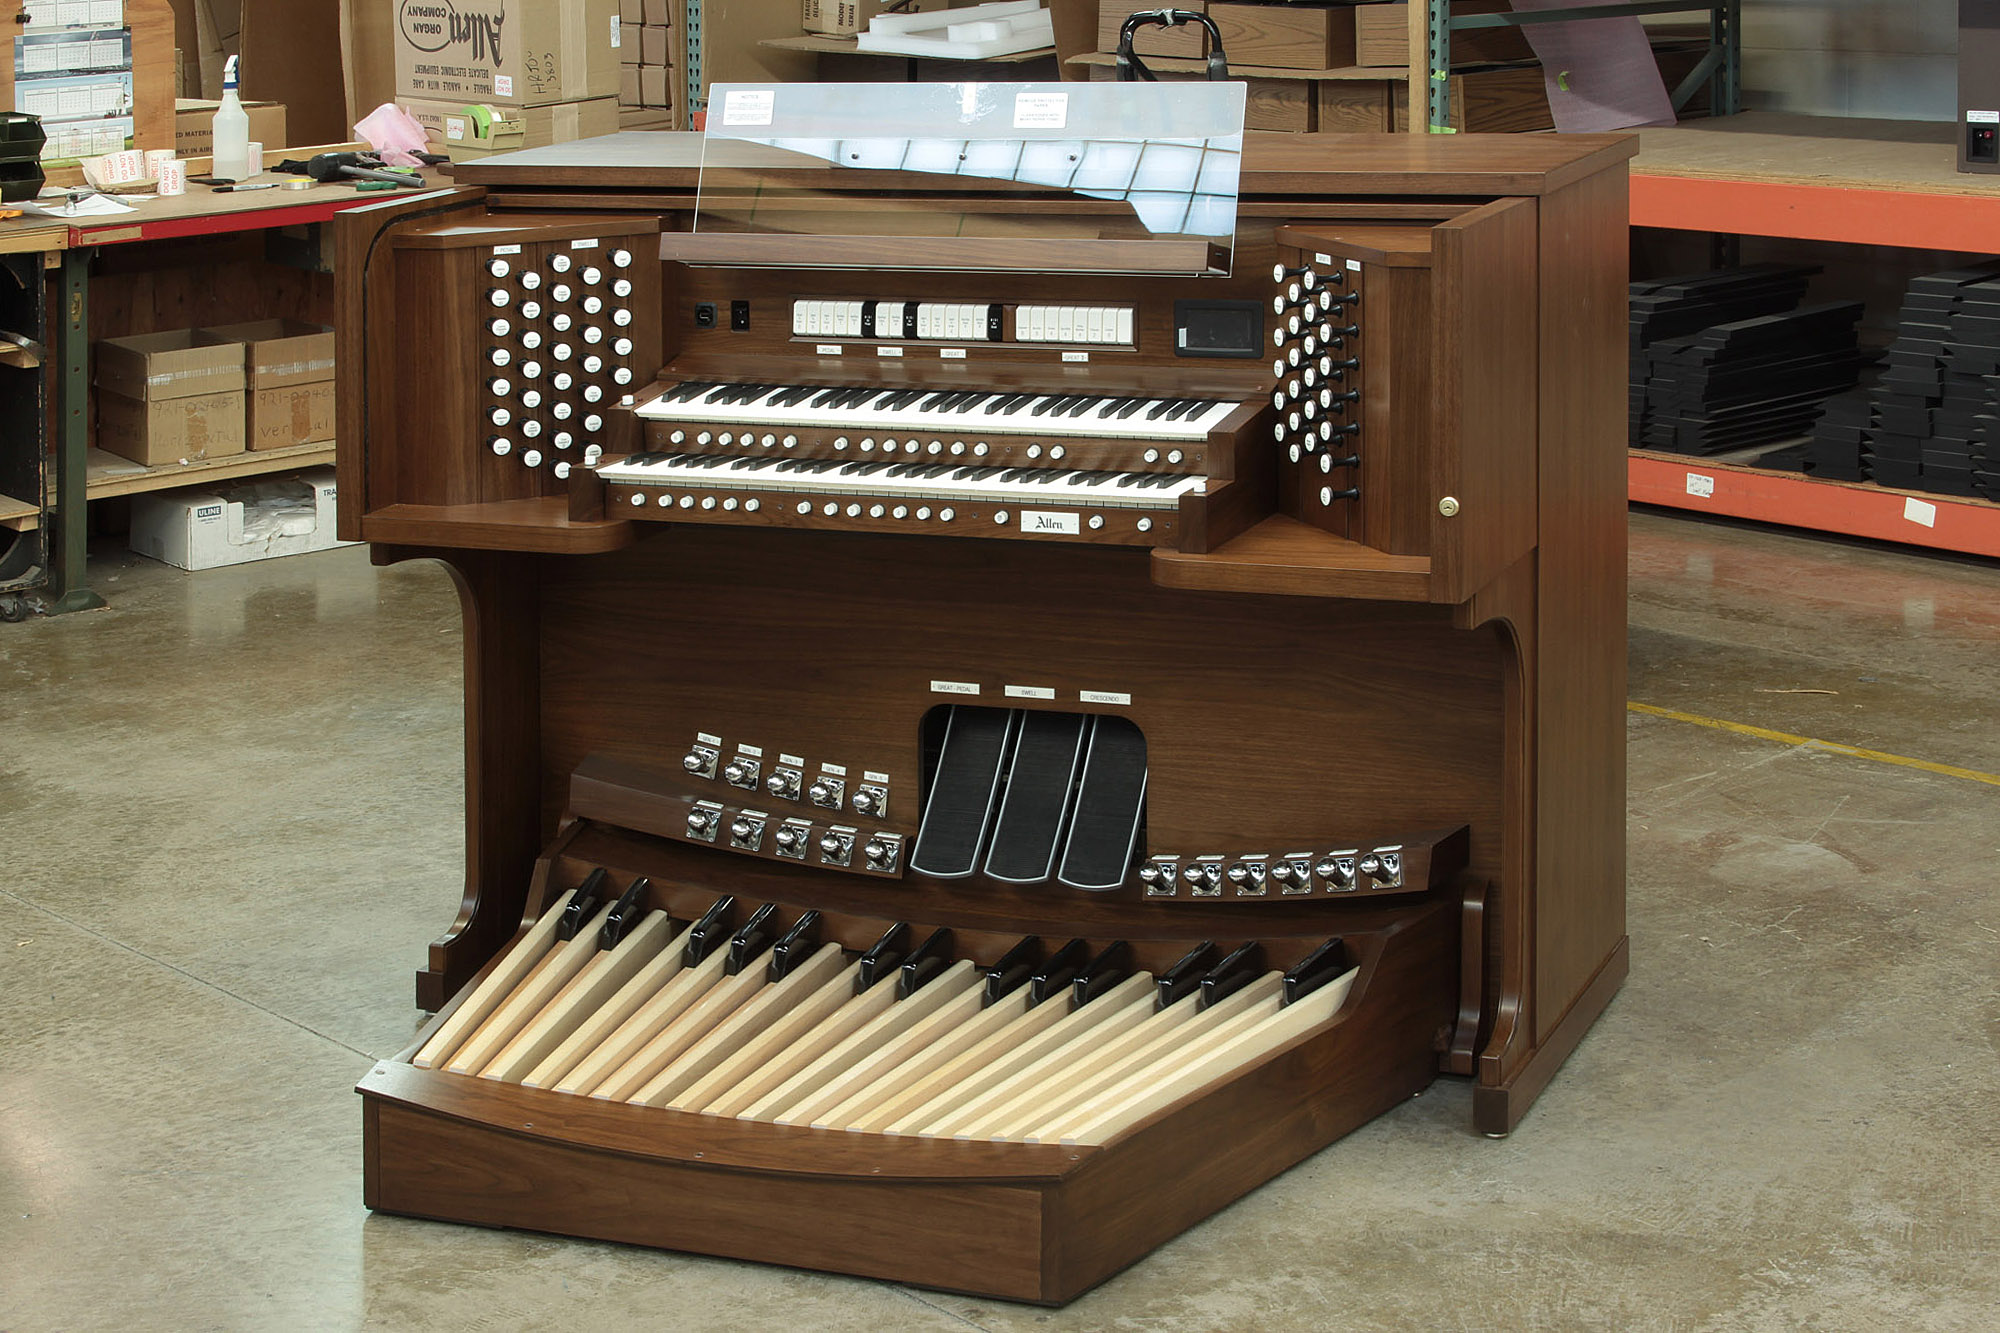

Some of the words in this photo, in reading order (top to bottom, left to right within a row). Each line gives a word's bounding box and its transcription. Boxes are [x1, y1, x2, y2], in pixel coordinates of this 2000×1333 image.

[408, 6, 446, 18] COMPANY
[413, 22, 442, 34] ORGAN
[448, 0, 505, 68] Allen
[414, 64, 440, 75] EQUIPMENT
[440, 66, 467, 77] ELECTRONIC
[468, 68, 489, 79] DELICATE
[412, 78, 425, 89] CARE
[428, 80, 440, 90] WITH
[442, 81, 461, 92] HANDLE
[473, 84, 492, 94] FRAGILE
[107, 159, 115, 179] DROP
[128, 155, 136, 176] DROP
[163, 182, 170, 194] DO
[198, 507, 221, 517] ULINE
[1035, 515, 1064, 531] Allen
